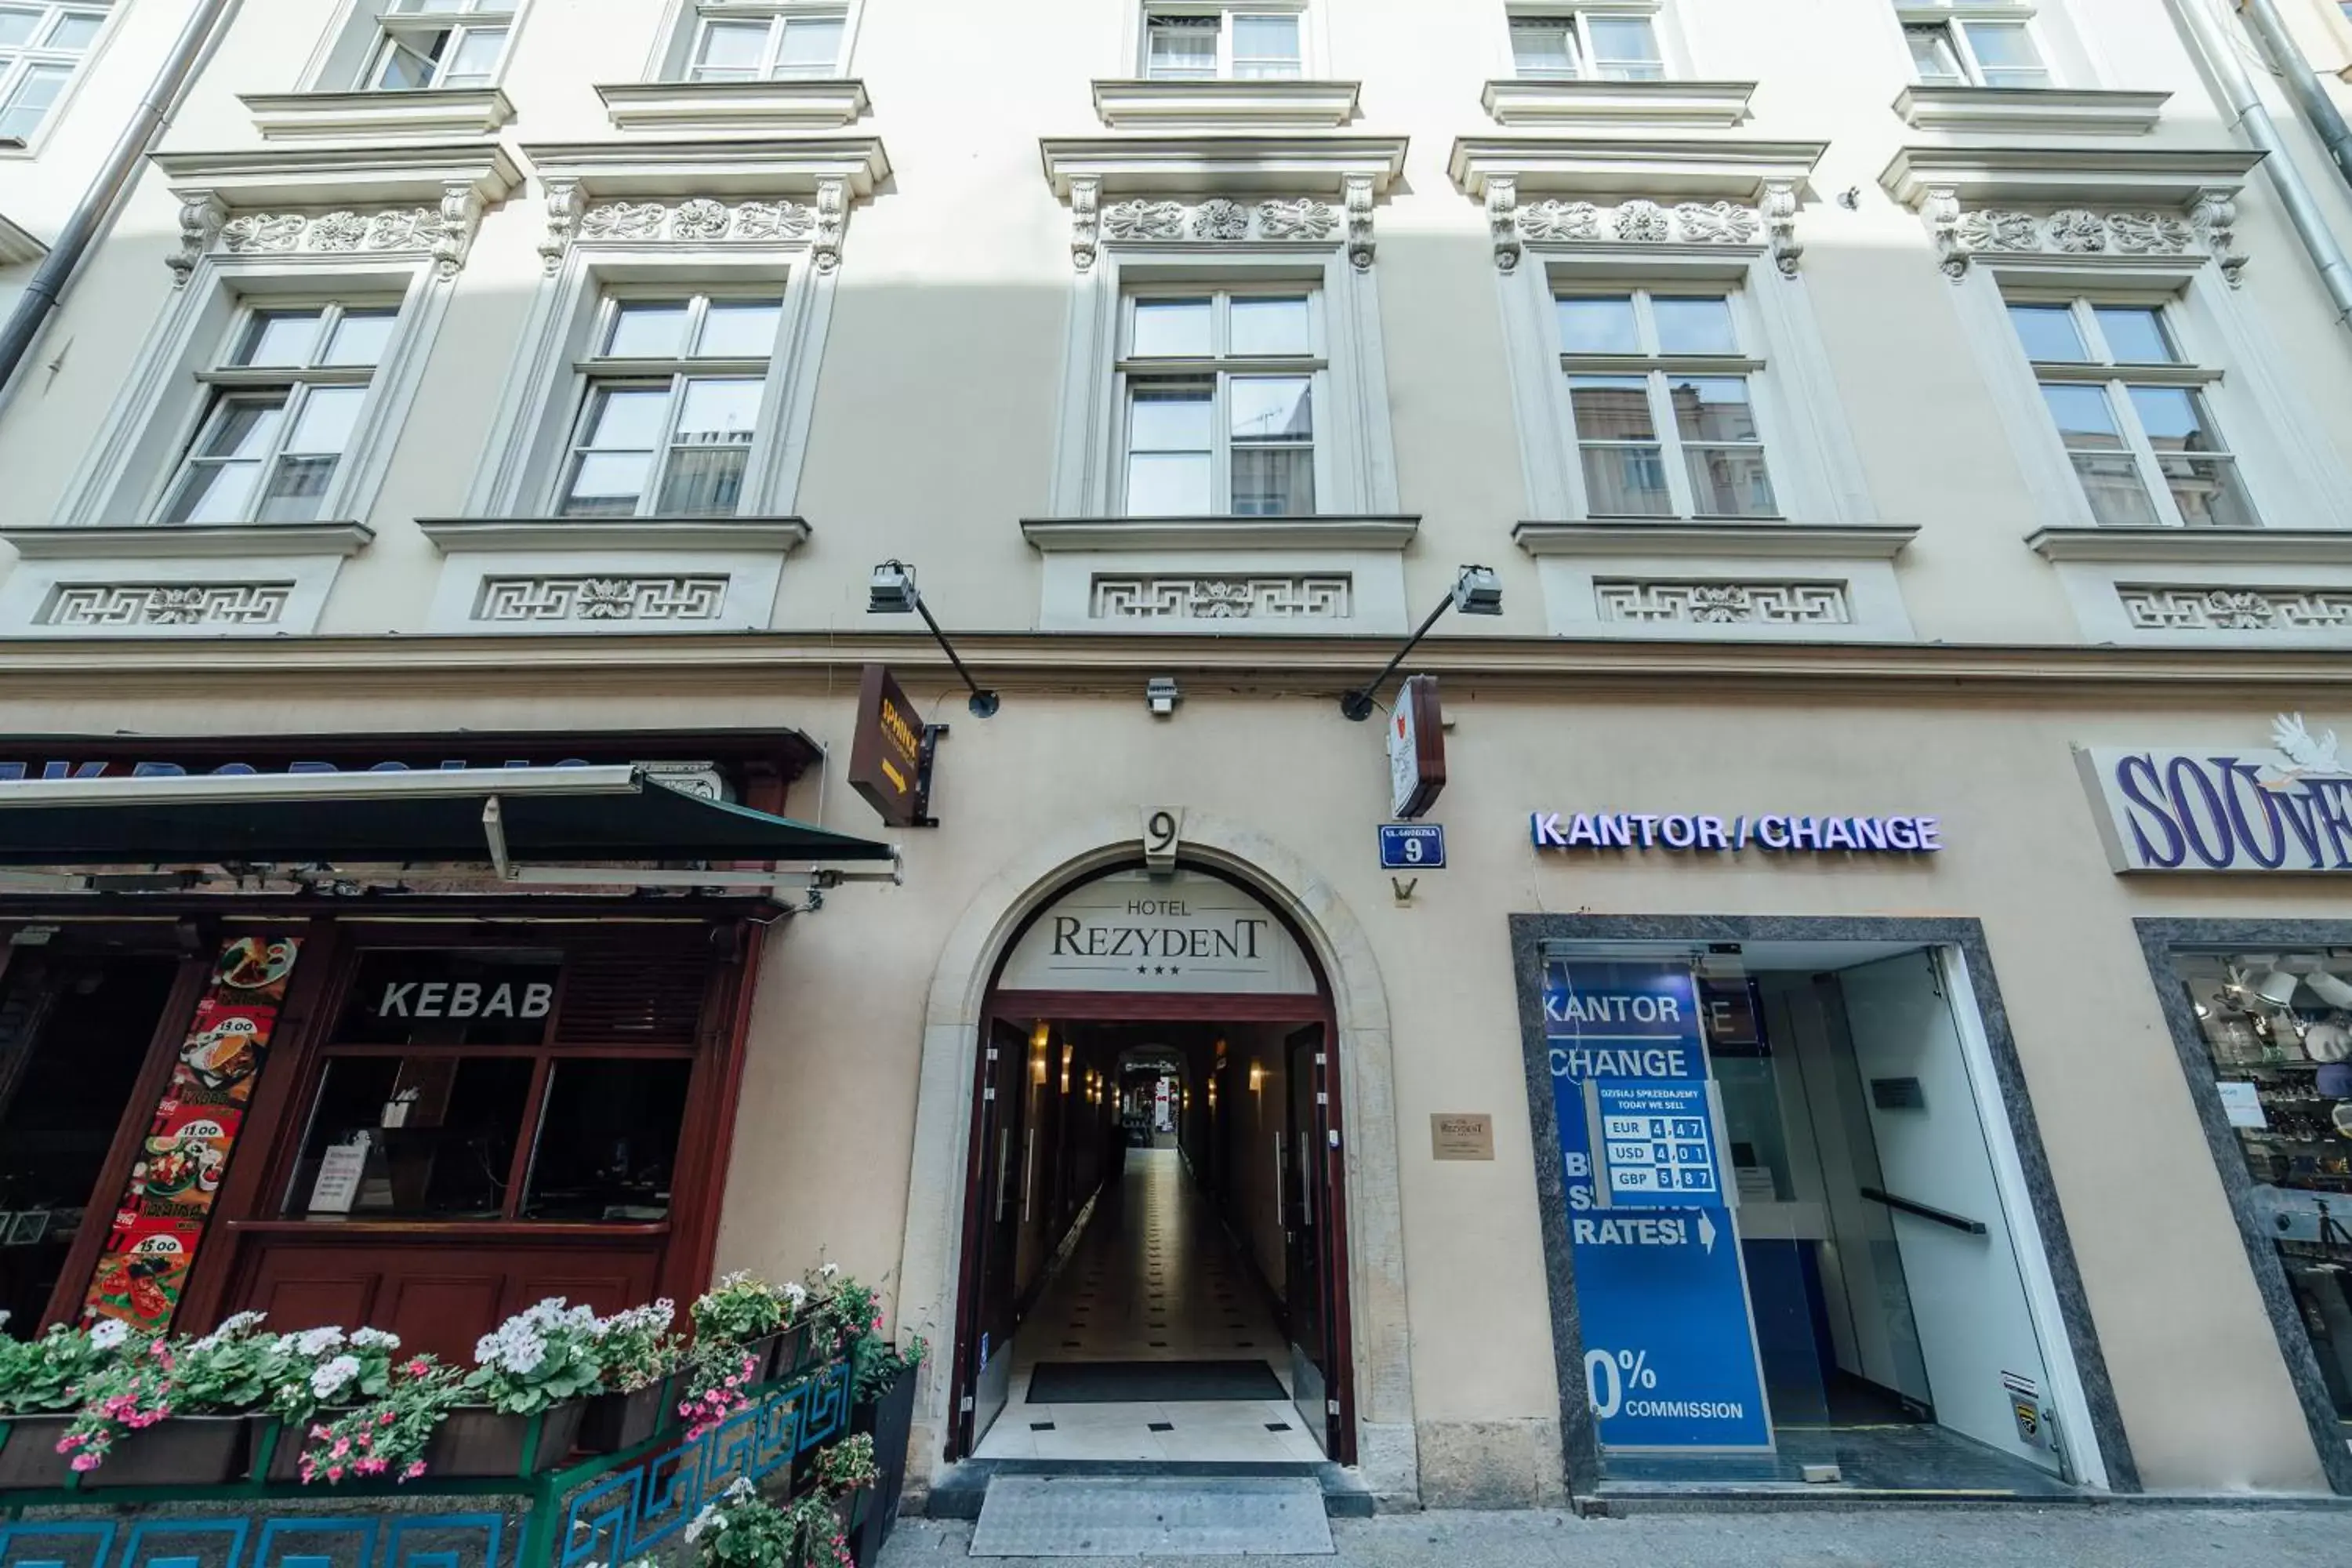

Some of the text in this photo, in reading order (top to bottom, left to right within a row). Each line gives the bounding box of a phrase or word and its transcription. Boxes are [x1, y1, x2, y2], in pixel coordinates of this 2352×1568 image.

[1148, 811, 1176, 852] 9
[1531, 812, 1727, 852] KANTOR
[1754, 815, 1943, 852] CHANGE
[1404, 838, 1422, 862] 9
[1127, 899, 1191, 916] HOTEL
[1049, 916, 1269, 959] REZYDENT
[379, 982, 553, 1018] KEBAB
[1542, 996, 1681, 1022] KANTOR
[1548, 1049, 1688, 1077] CHANGE
[1613, 1123, 1639, 1133] EUR
[1616, 1148, 1644, 1159] USD
[1619, 1174, 1646, 1185] GBP
[1573, 1220, 1687, 1245] RATES!
[1584, 1349, 1657, 1419] 0%
[1625, 1400, 1744, 1420] COMMISSION
